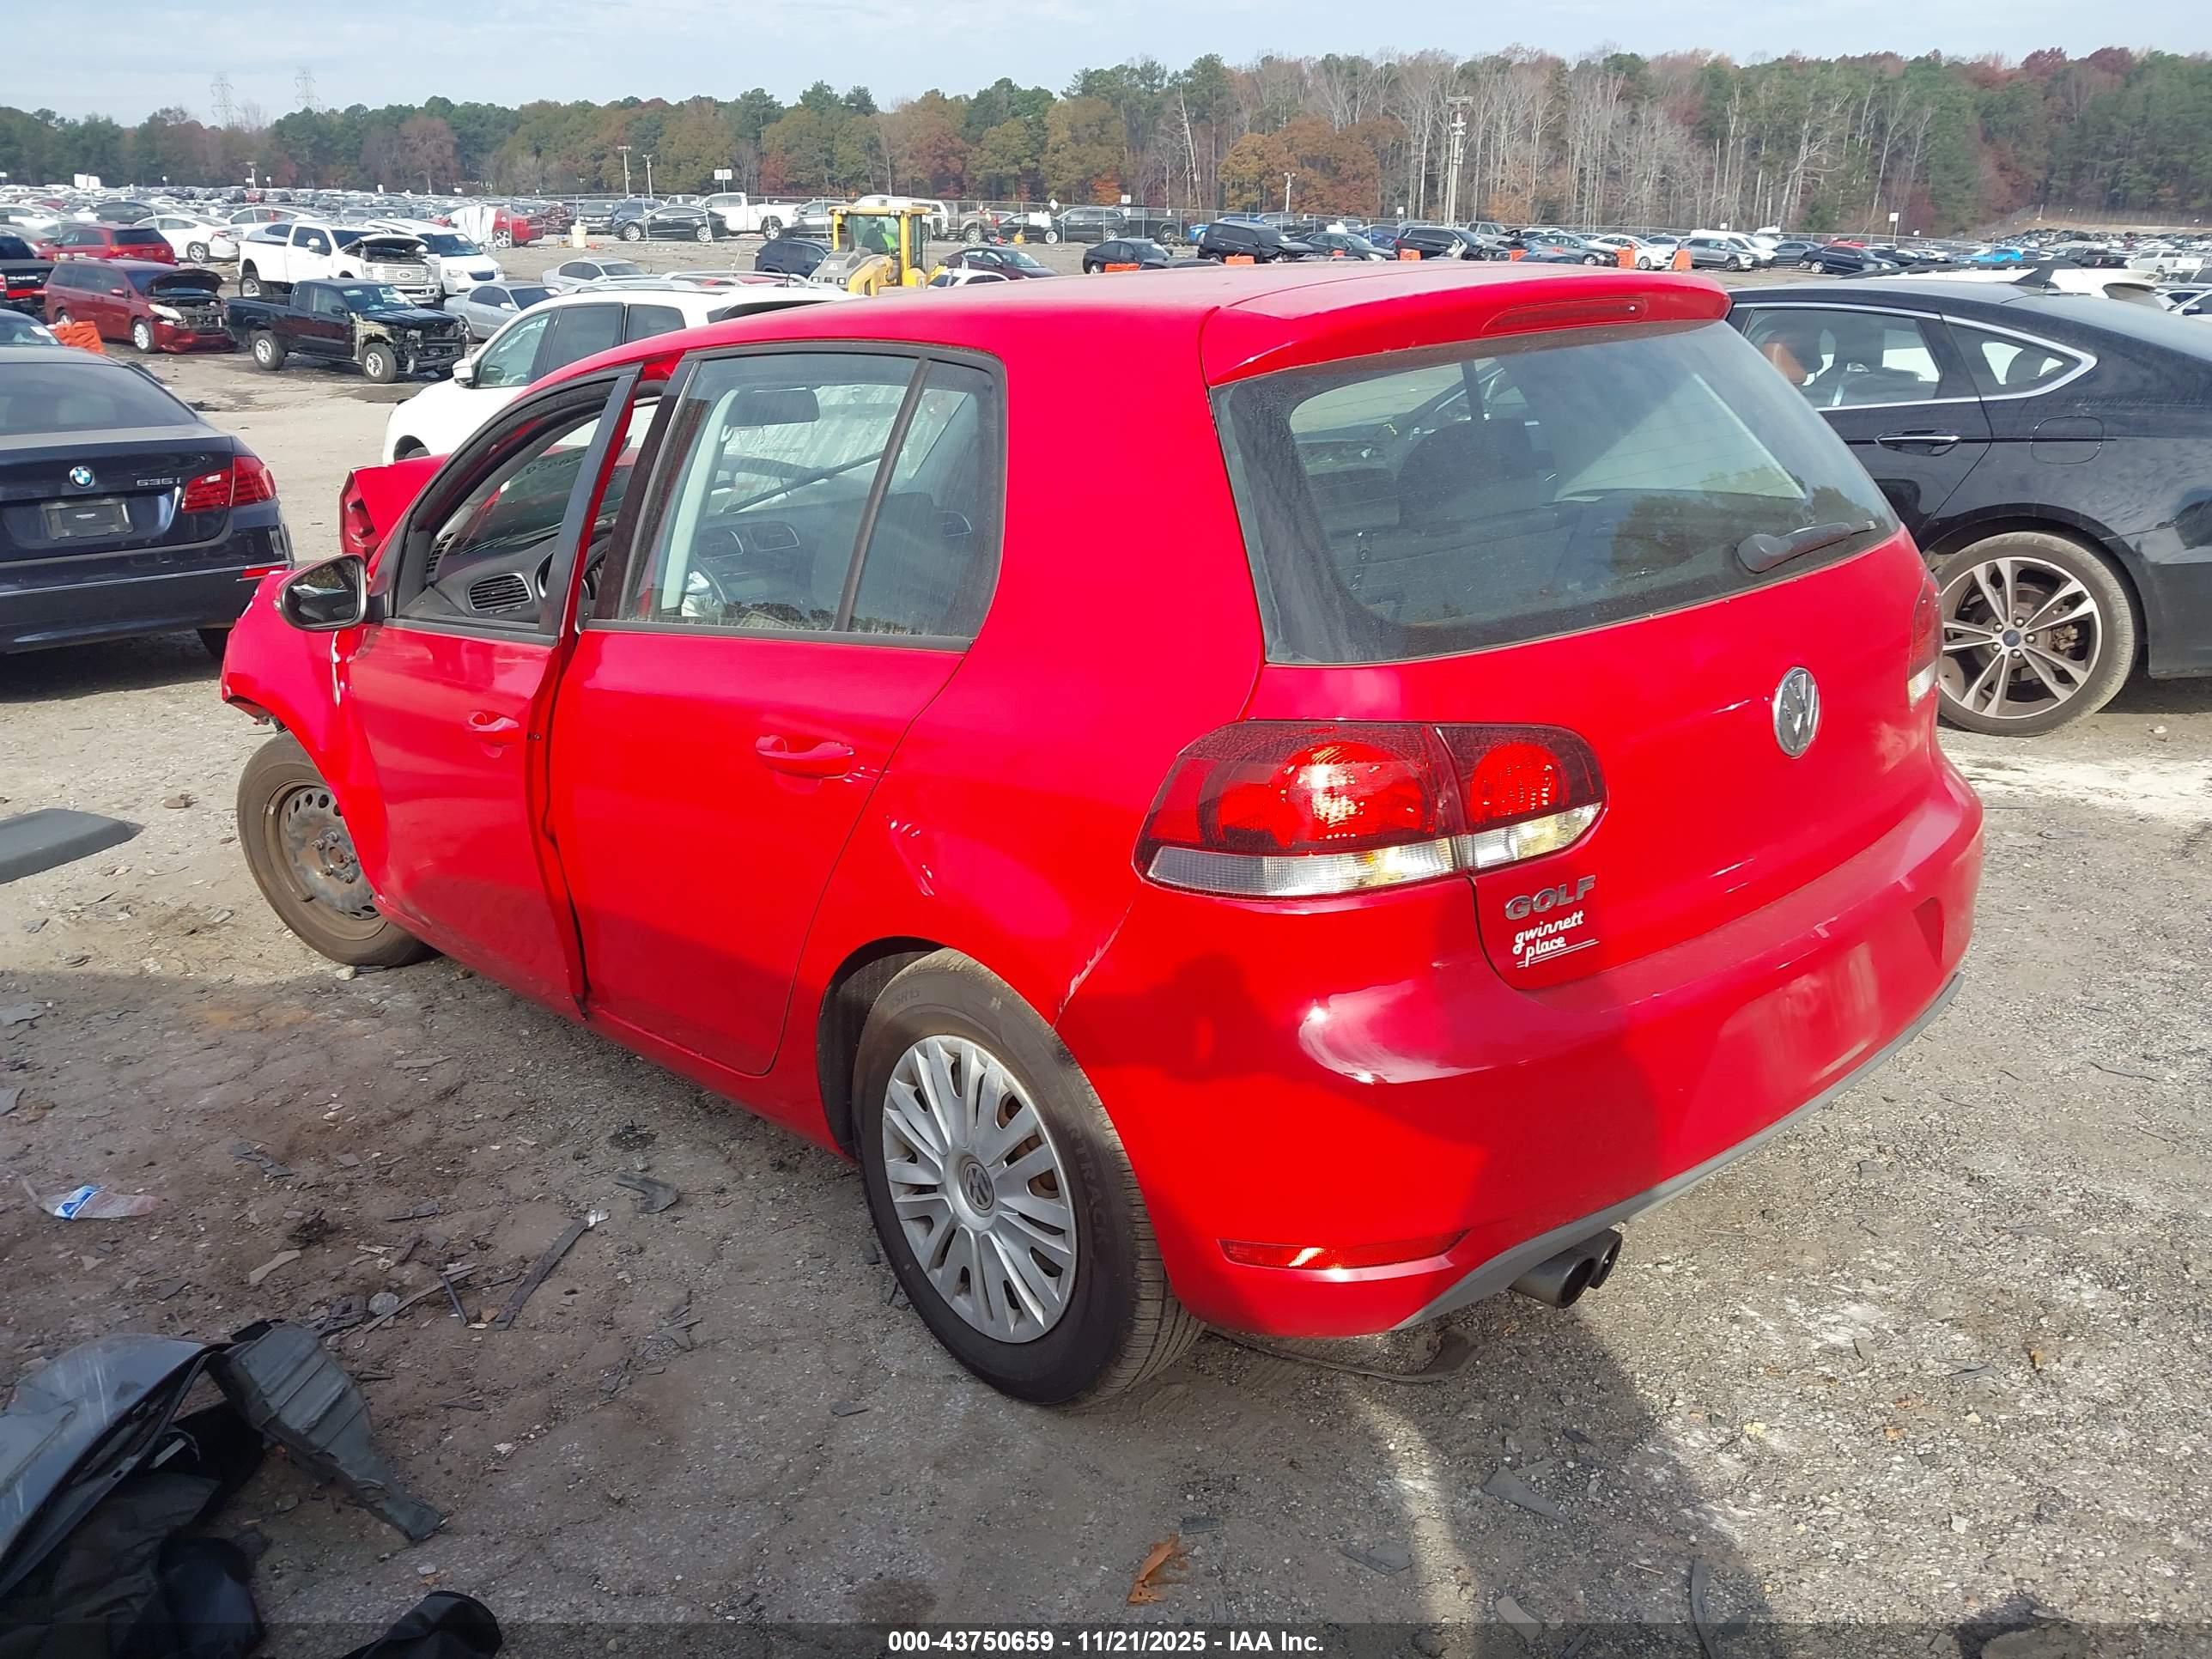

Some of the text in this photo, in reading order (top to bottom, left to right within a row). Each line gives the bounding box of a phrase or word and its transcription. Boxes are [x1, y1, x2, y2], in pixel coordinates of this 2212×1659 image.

[1504, 874, 1596, 921] GOLF
[1512, 910, 1584, 955] gwinnett
[1525, 936, 1567, 968] place
